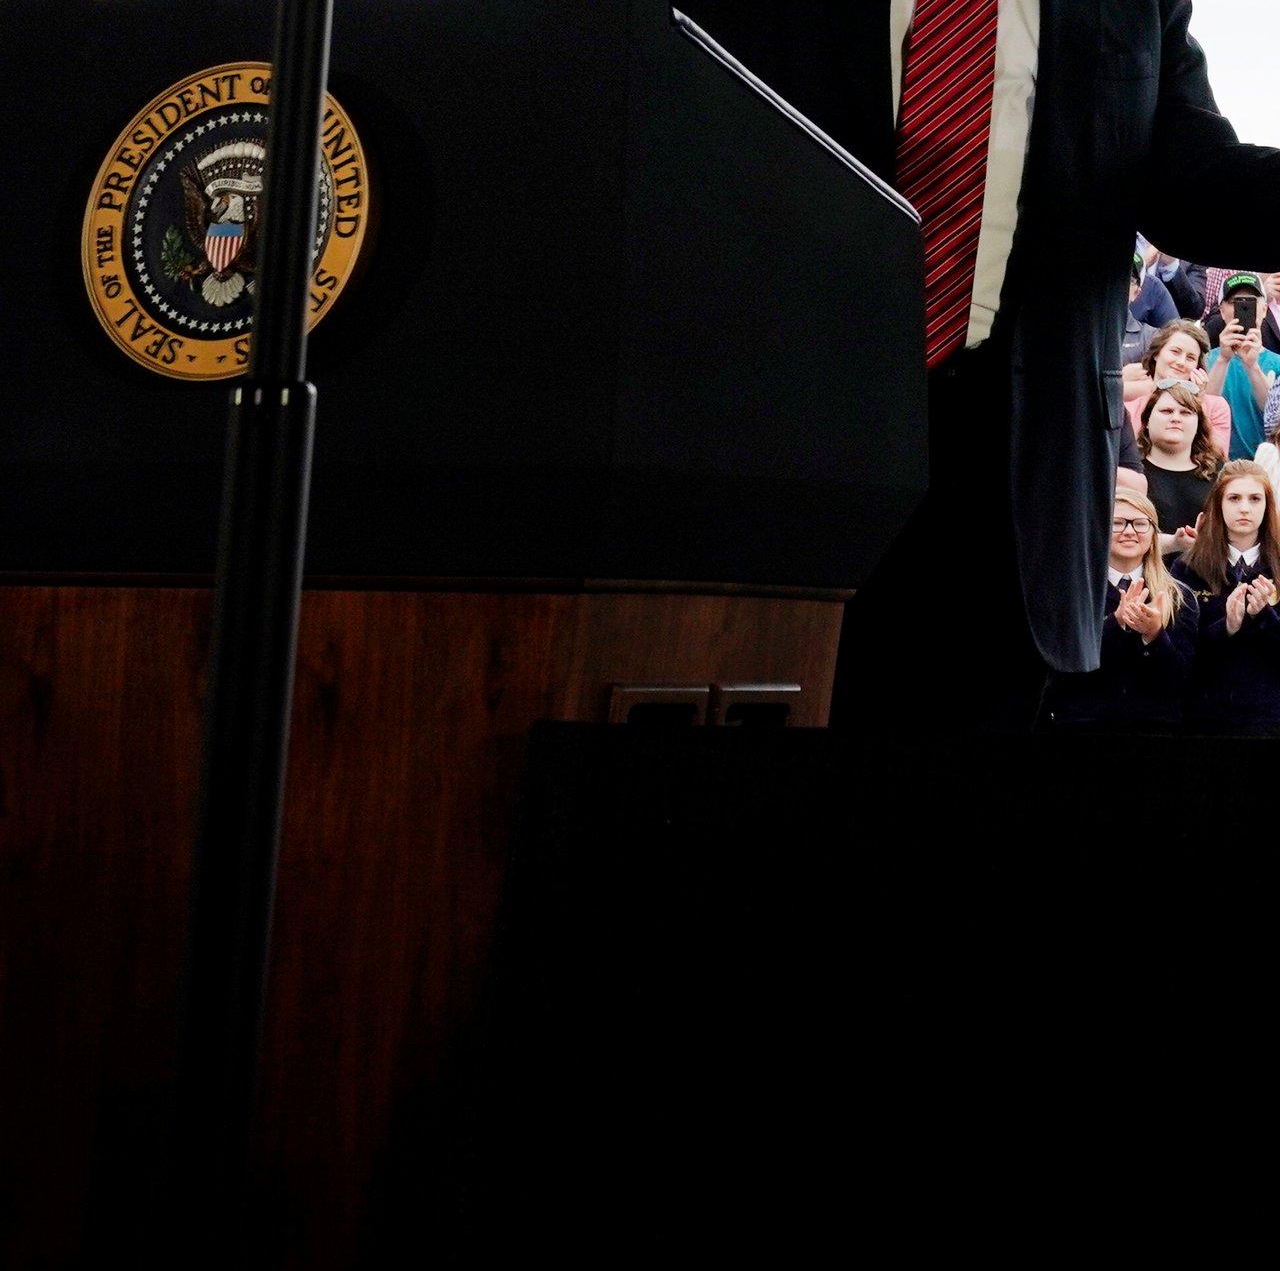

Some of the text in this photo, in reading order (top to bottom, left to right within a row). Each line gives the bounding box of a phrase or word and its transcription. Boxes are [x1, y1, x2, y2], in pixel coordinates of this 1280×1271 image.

[97, 73, 241, 212] PRESIDENT
[96, 225, 114, 268] THE
[101, 274, 122, 299] OF
[115, 299, 184, 365] SEAL
